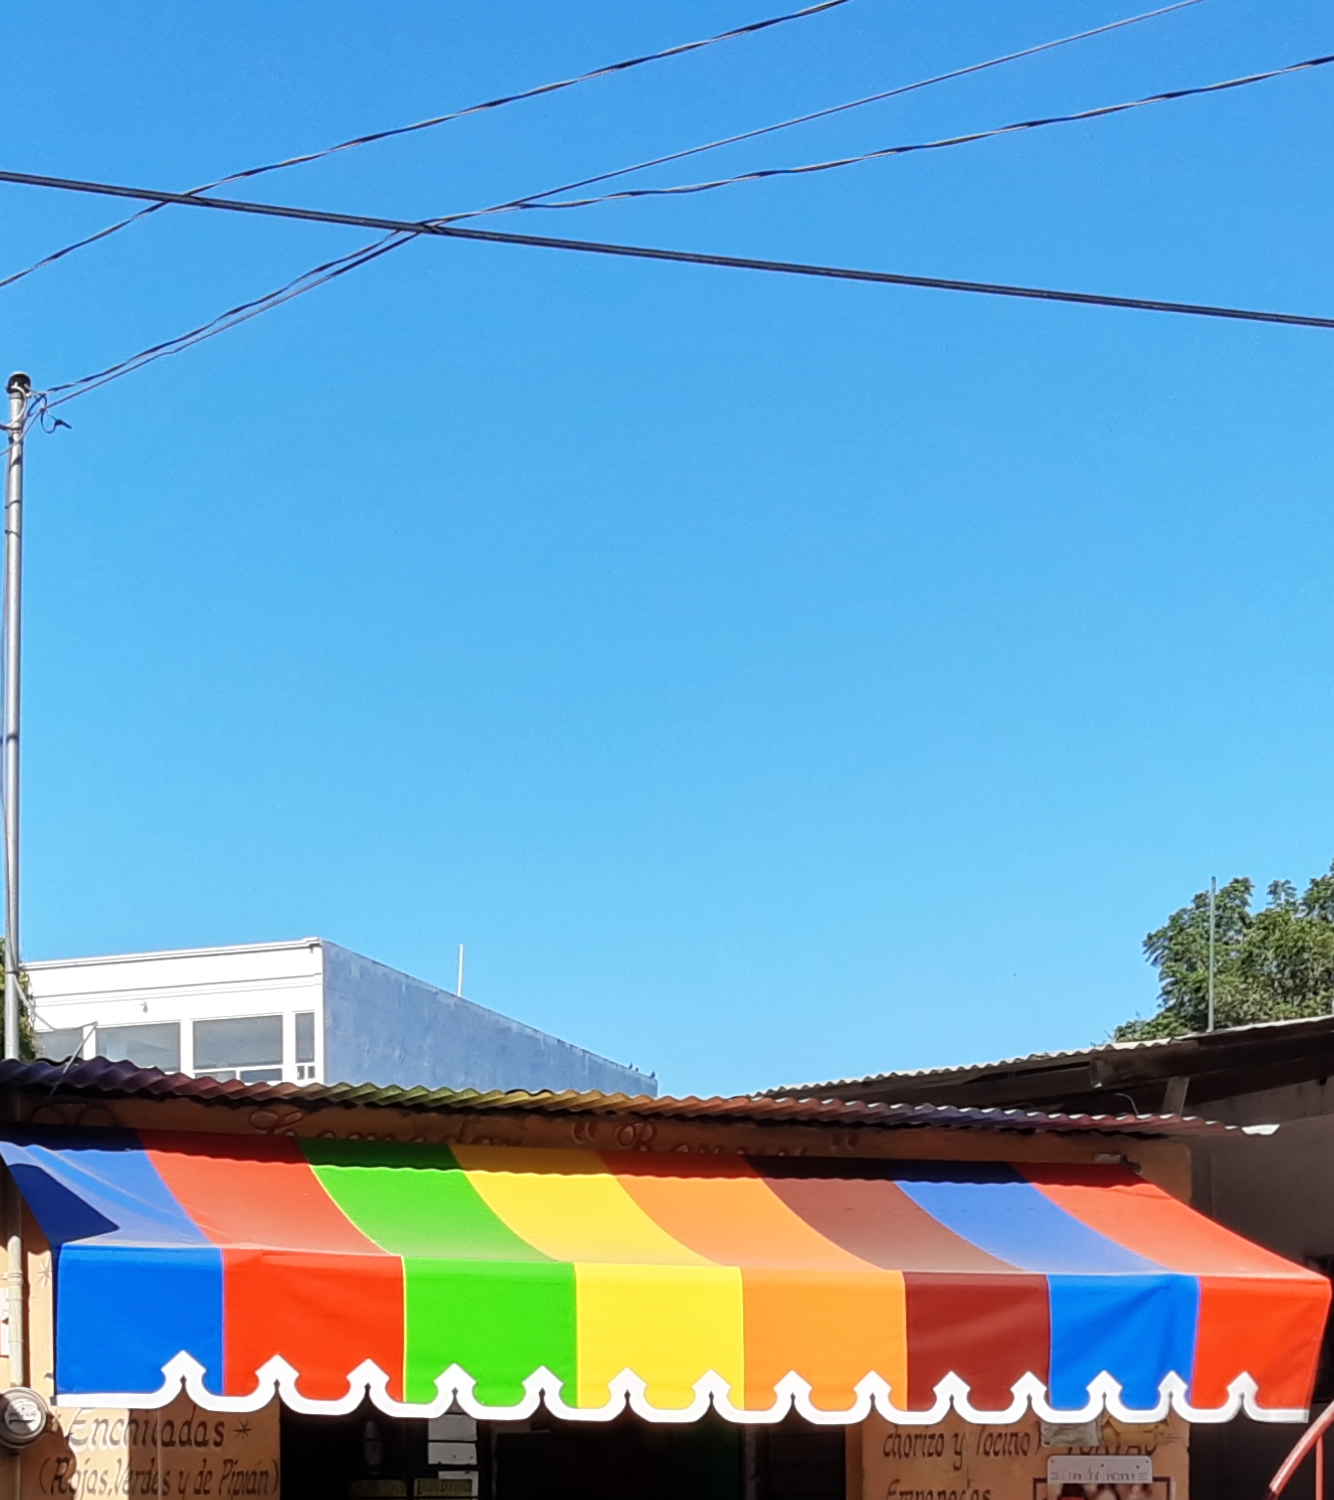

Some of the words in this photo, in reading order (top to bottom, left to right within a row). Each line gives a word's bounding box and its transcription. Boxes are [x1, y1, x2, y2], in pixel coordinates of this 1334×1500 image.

[68, 1404, 225, 1449] Enchiladas
[881, 1424, 944, 1459] chorizo
[949, 1432, 965, 1471] y
[194, 1458, 213, 1496] de
